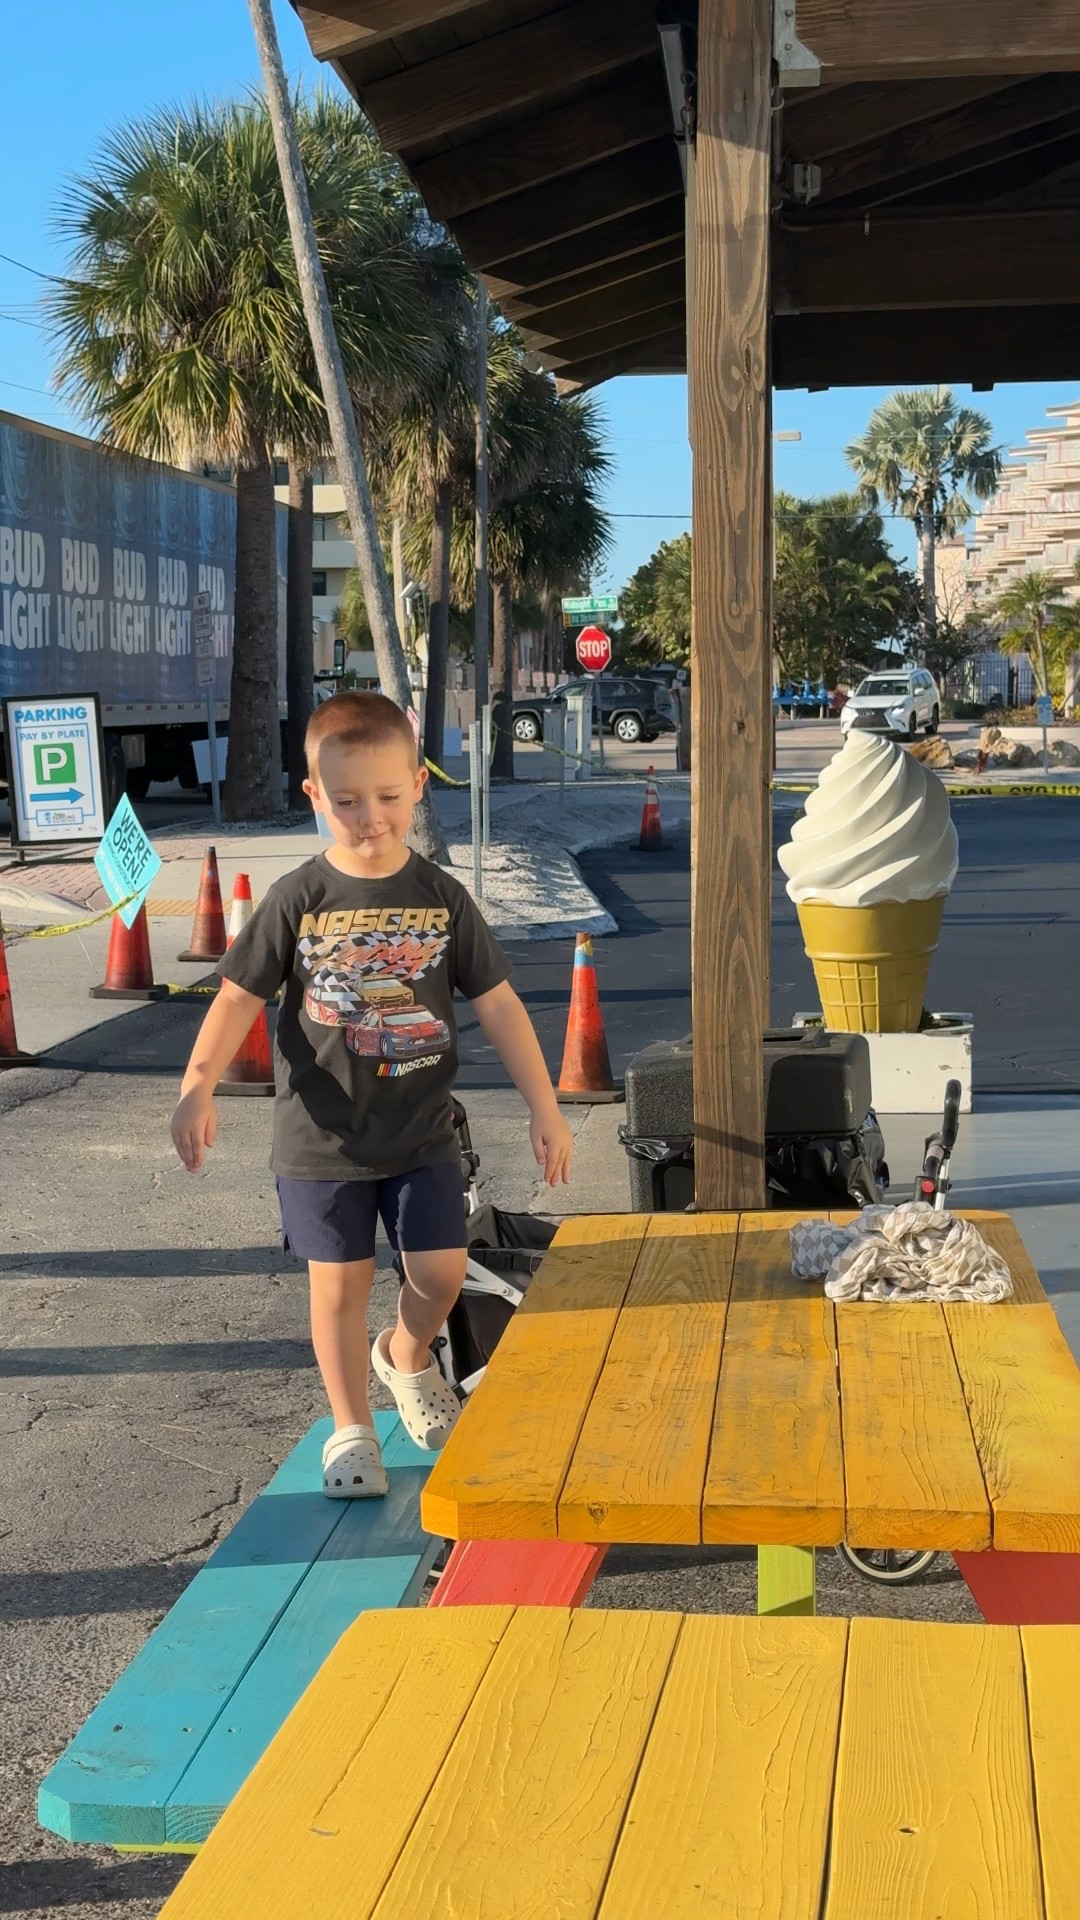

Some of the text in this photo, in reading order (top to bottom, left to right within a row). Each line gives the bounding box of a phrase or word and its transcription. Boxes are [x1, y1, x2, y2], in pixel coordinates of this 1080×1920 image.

[0, 526, 45, 588] BUD
[61, 538, 100, 595] BUD
[113, 548, 146, 601] BUD
[158, 556, 188, 606] BUD
[198, 564, 225, 611] BUD
[57, 594, 104, 653] LIGHT
[109, 601, 150, 655] LIGHT
[155, 606, 191, 657] LIGHT
[579, 640, 608, 658] STOP
[14, 706, 87, 723] PARKING
[20, 729, 85, 741] PAY BY PLATE
[40, 747, 68, 782] P
[113, 827, 143, 885] OPEN!
[121, 808, 152, 868] WE'RE
[299, 907, 450, 938] NASCAR
[307, 934, 445, 982] Racing
[395, 1055, 442, 1077] NASCAR
